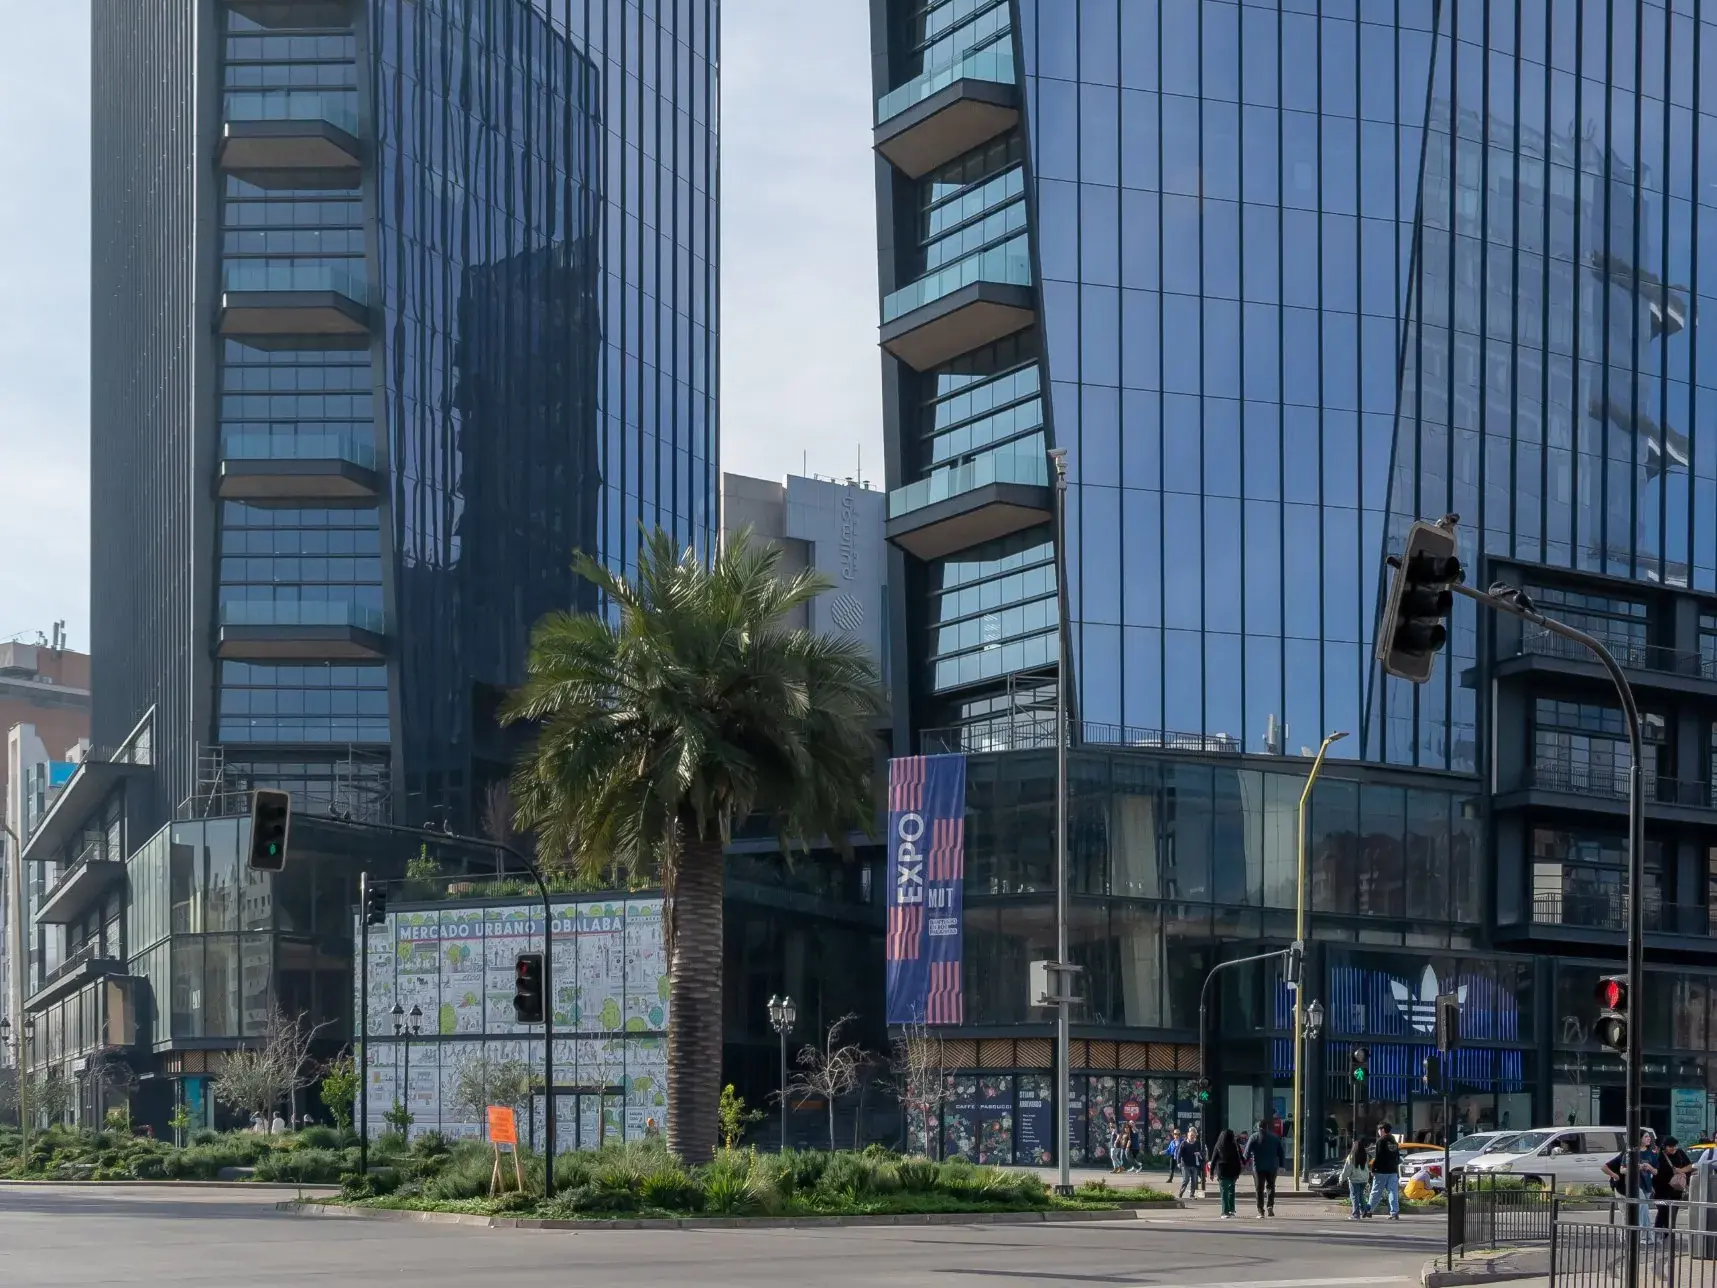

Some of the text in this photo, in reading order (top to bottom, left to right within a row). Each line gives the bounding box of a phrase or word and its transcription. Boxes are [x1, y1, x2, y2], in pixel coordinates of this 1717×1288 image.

[898, 813, 924, 903] EXPO
[929, 887, 953, 908] MUT
[400, 916, 622, 940] MERCADO URBANO OBALABA
